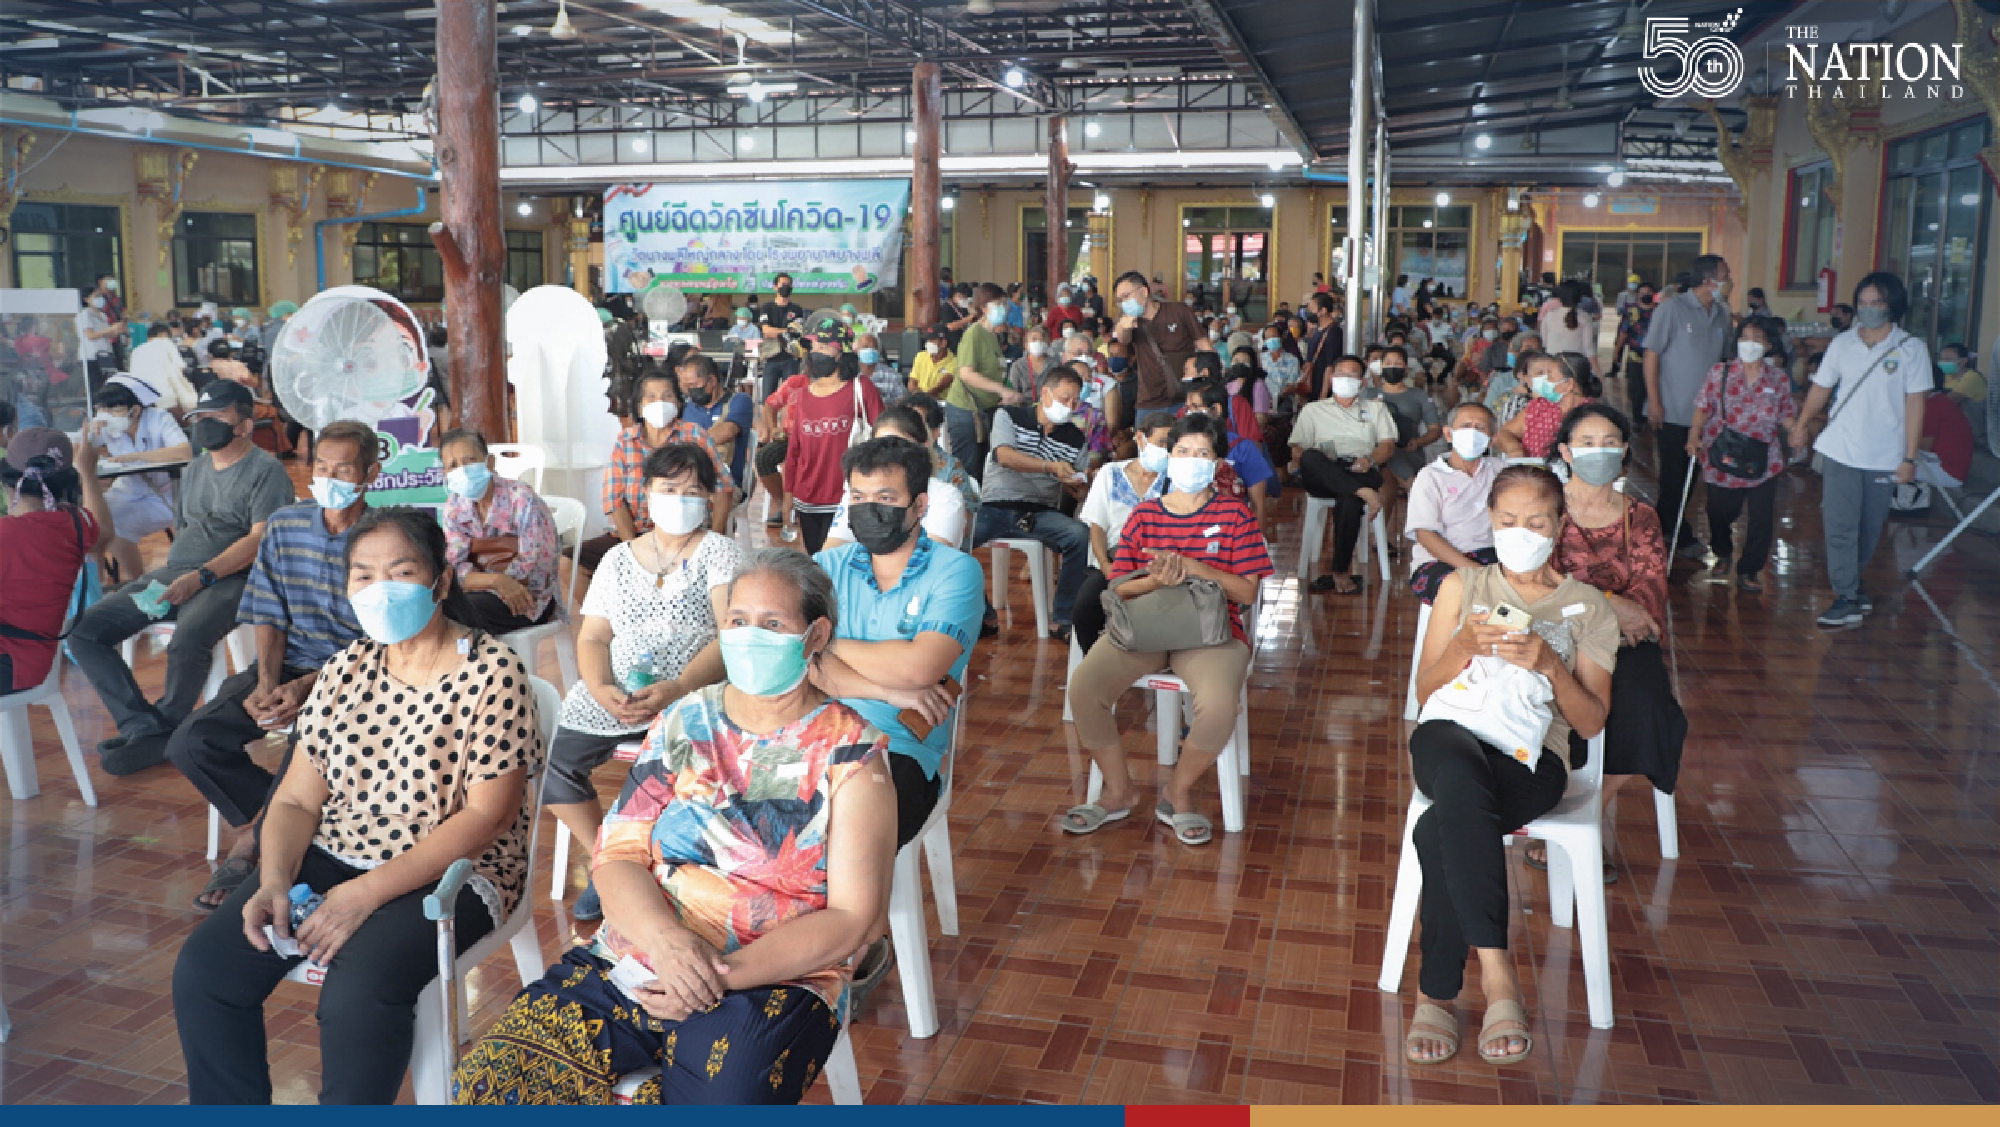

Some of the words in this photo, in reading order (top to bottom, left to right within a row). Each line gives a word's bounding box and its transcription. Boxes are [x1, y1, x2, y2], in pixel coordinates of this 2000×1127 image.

[619, 200, 892, 242] ศูนย์ฉีดวัคซีนโควิด-19
